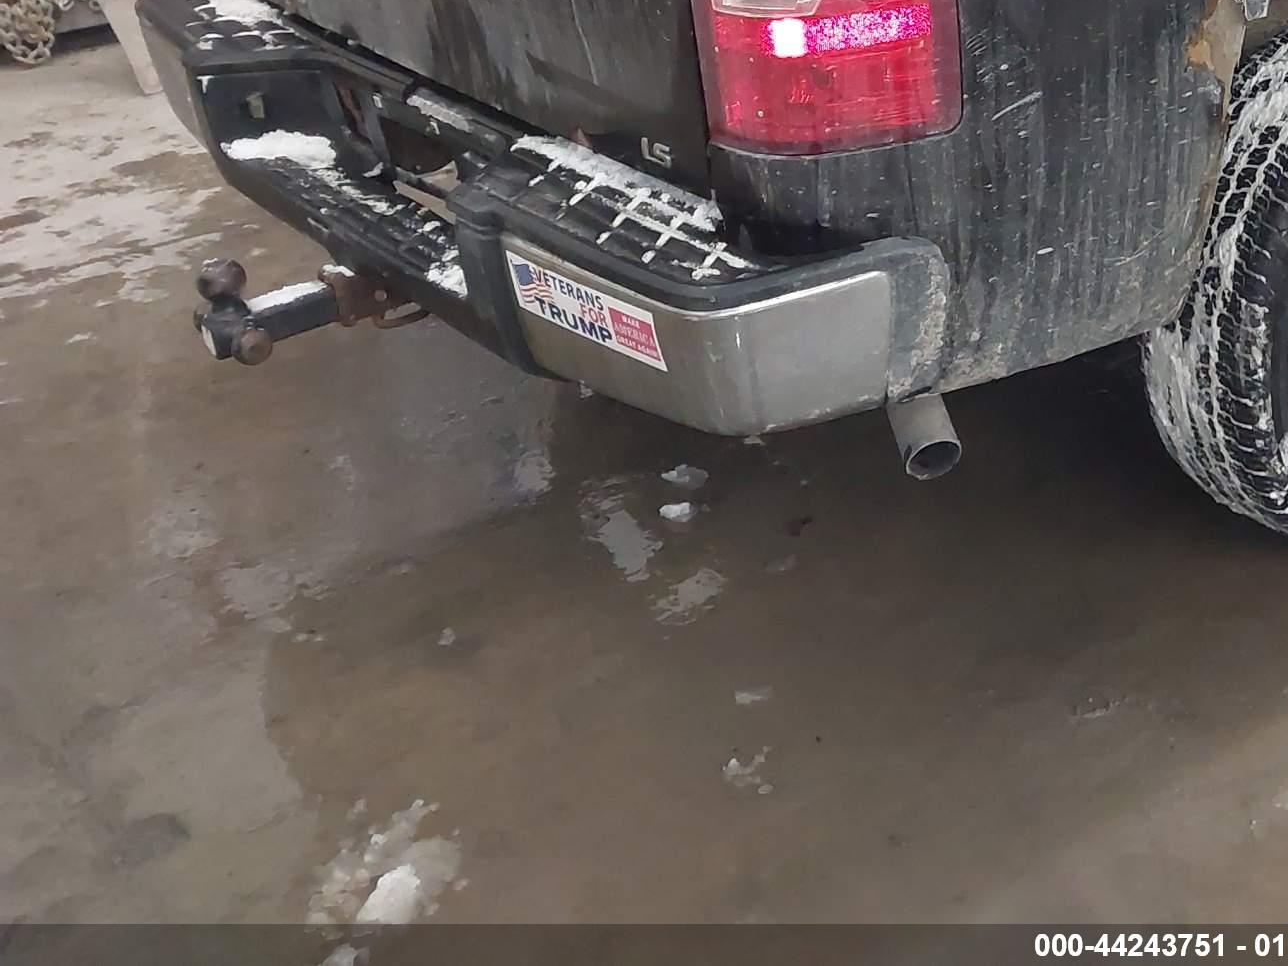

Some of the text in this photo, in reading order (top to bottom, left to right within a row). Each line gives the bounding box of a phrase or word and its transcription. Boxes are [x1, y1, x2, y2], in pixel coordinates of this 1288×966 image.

[641, 137, 672, 169] LS
[532, 266, 605, 312] VETERANS
[534, 295, 613, 343] TRUMP
[579, 303, 609, 328] FOR
[614, 322, 657, 347] AMERICA
